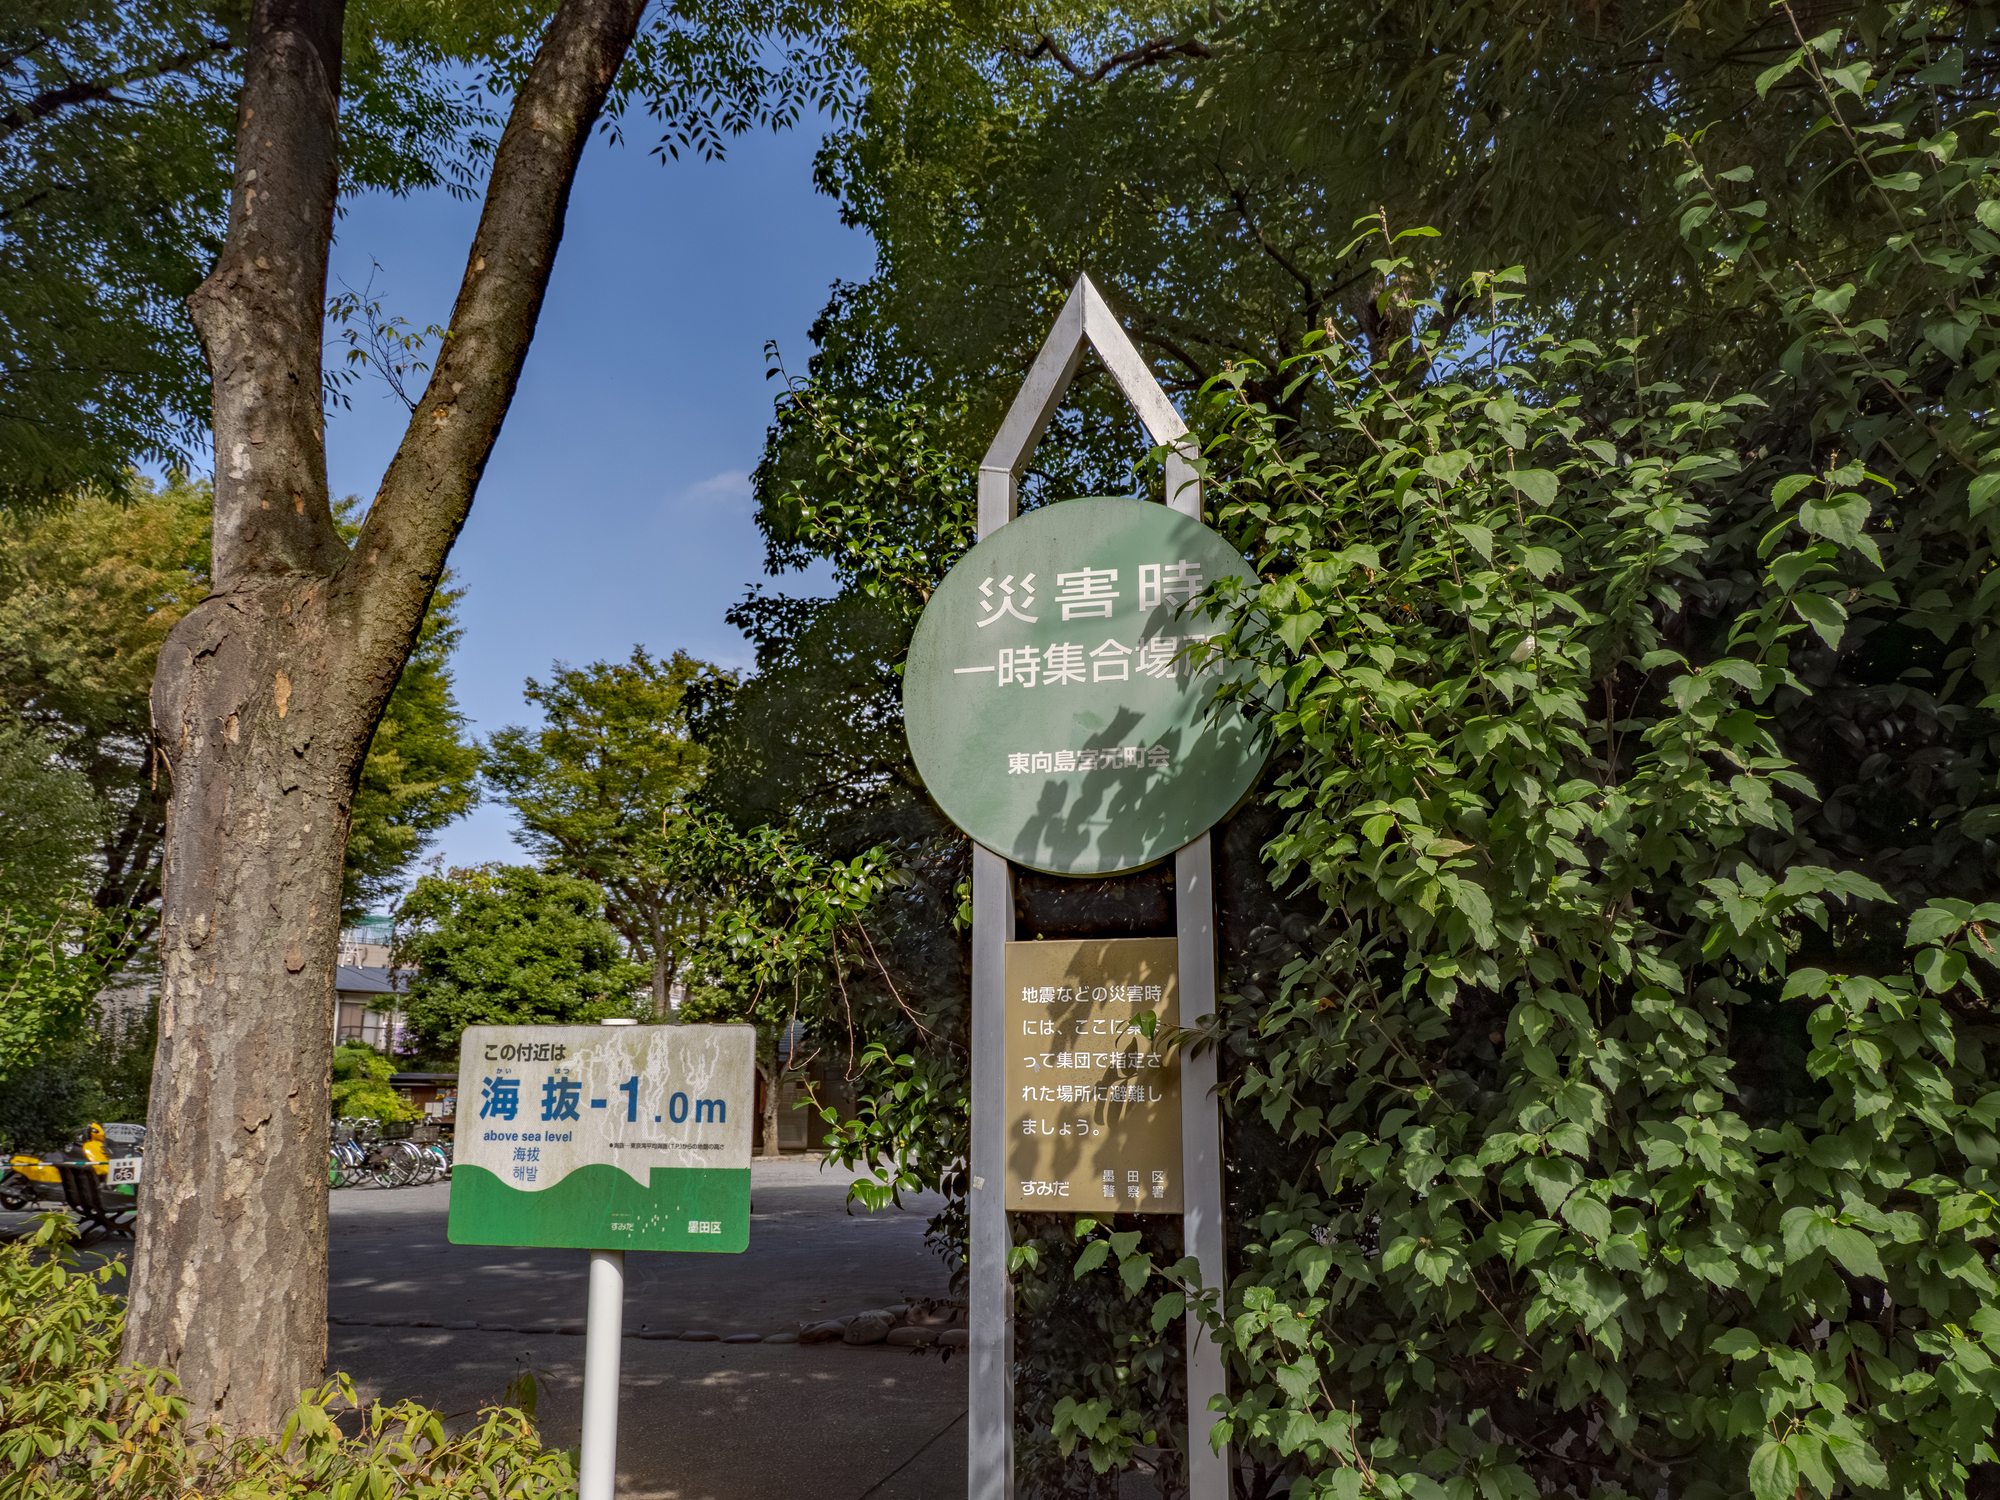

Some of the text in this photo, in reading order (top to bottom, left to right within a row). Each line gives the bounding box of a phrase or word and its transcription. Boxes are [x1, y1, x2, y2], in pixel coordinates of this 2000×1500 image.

[976, 559, 1204, 628] 災害時
[953, 632, 1226, 688] 一時集合場所
[1008, 745, 1170, 775] 東向島宮元町会
[1022, 985, 1162, 1004] 地震などの災害時
[484, 1043, 567, 1062] この付近は
[1023, 1052, 1162, 1069] って集団で指定さ
[1022, 1085, 1162, 1103] れた場所に避難し
[483, 1130, 573, 1142] above sea level
[1022, 1119, 1100, 1136] ましょう。
[513, 1166, 539, 1182] 해발
[1021, 1181, 1070, 1197] すみだ
[611, 1222, 634, 1231] すみだ
[688, 1221, 722, 1234] 墨田区
